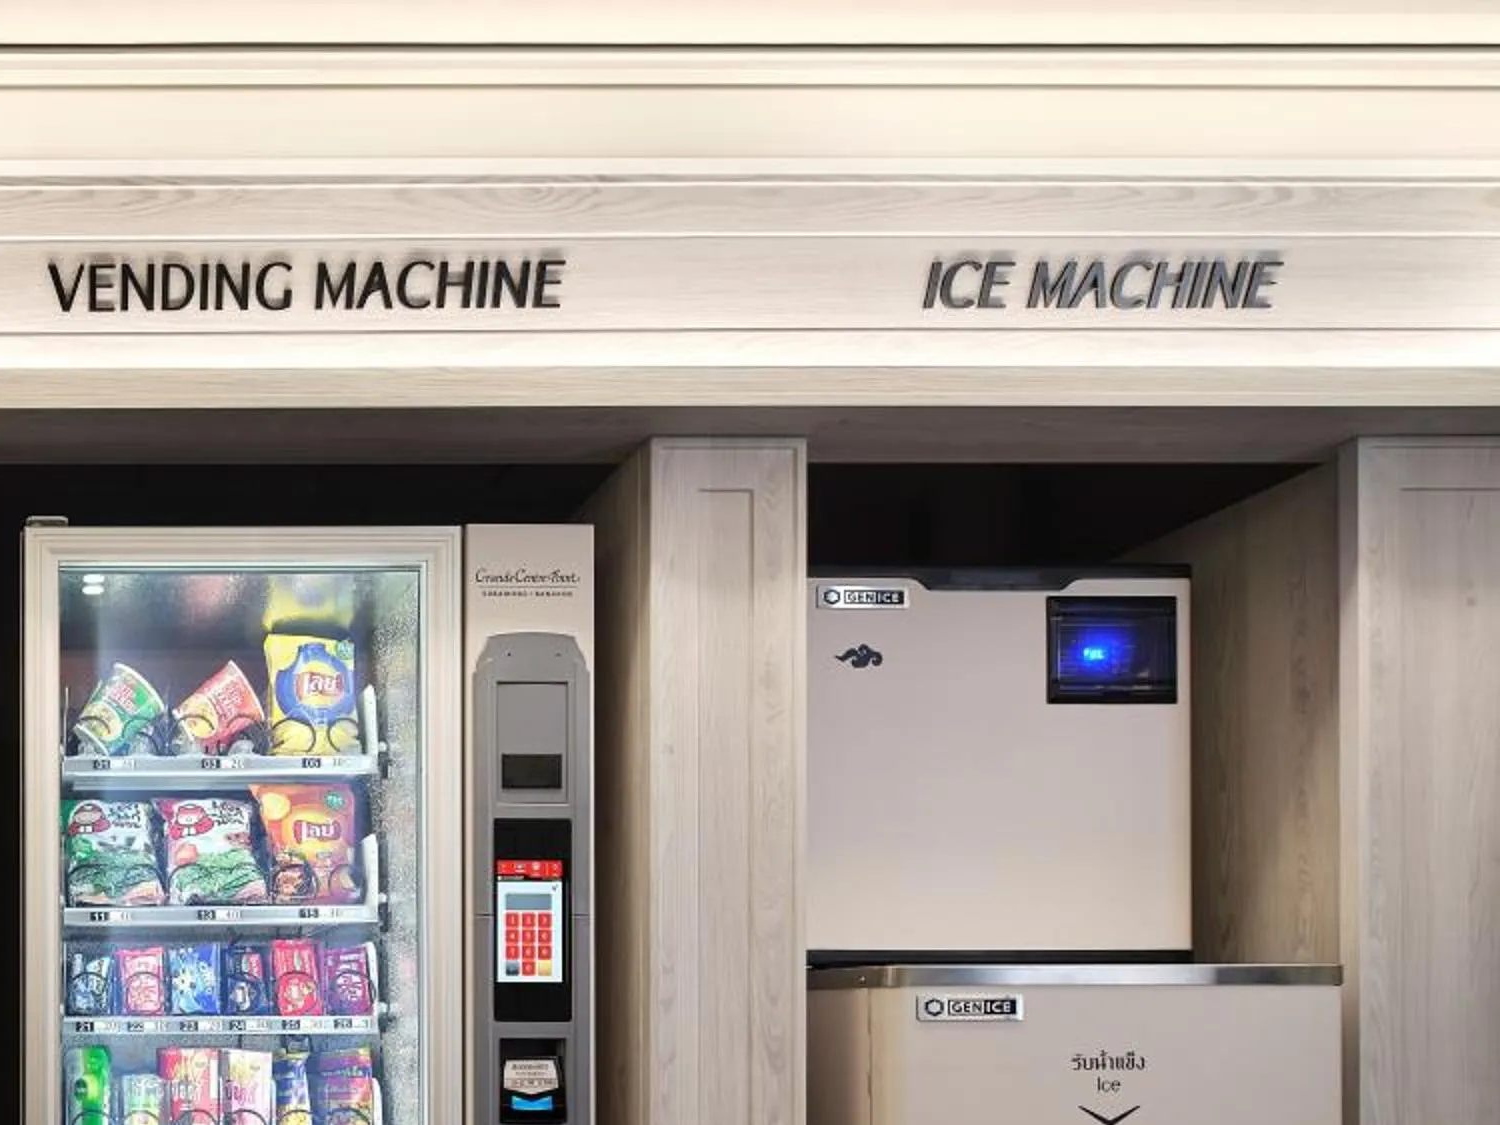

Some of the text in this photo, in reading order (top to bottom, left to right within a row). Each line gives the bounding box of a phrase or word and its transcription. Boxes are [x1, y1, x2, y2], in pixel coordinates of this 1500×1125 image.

[47, 259, 567, 312] VENDING MACHINE
[922, 260, 1285, 310] ICE MACHINE
[845, 590, 902, 604] GENICE
[949, 1000, 1012, 1014] GENICE
[1071, 1049, 1146, 1071] รับน้ำแข็ง
[1097, 1076, 1121, 1092] Ice
